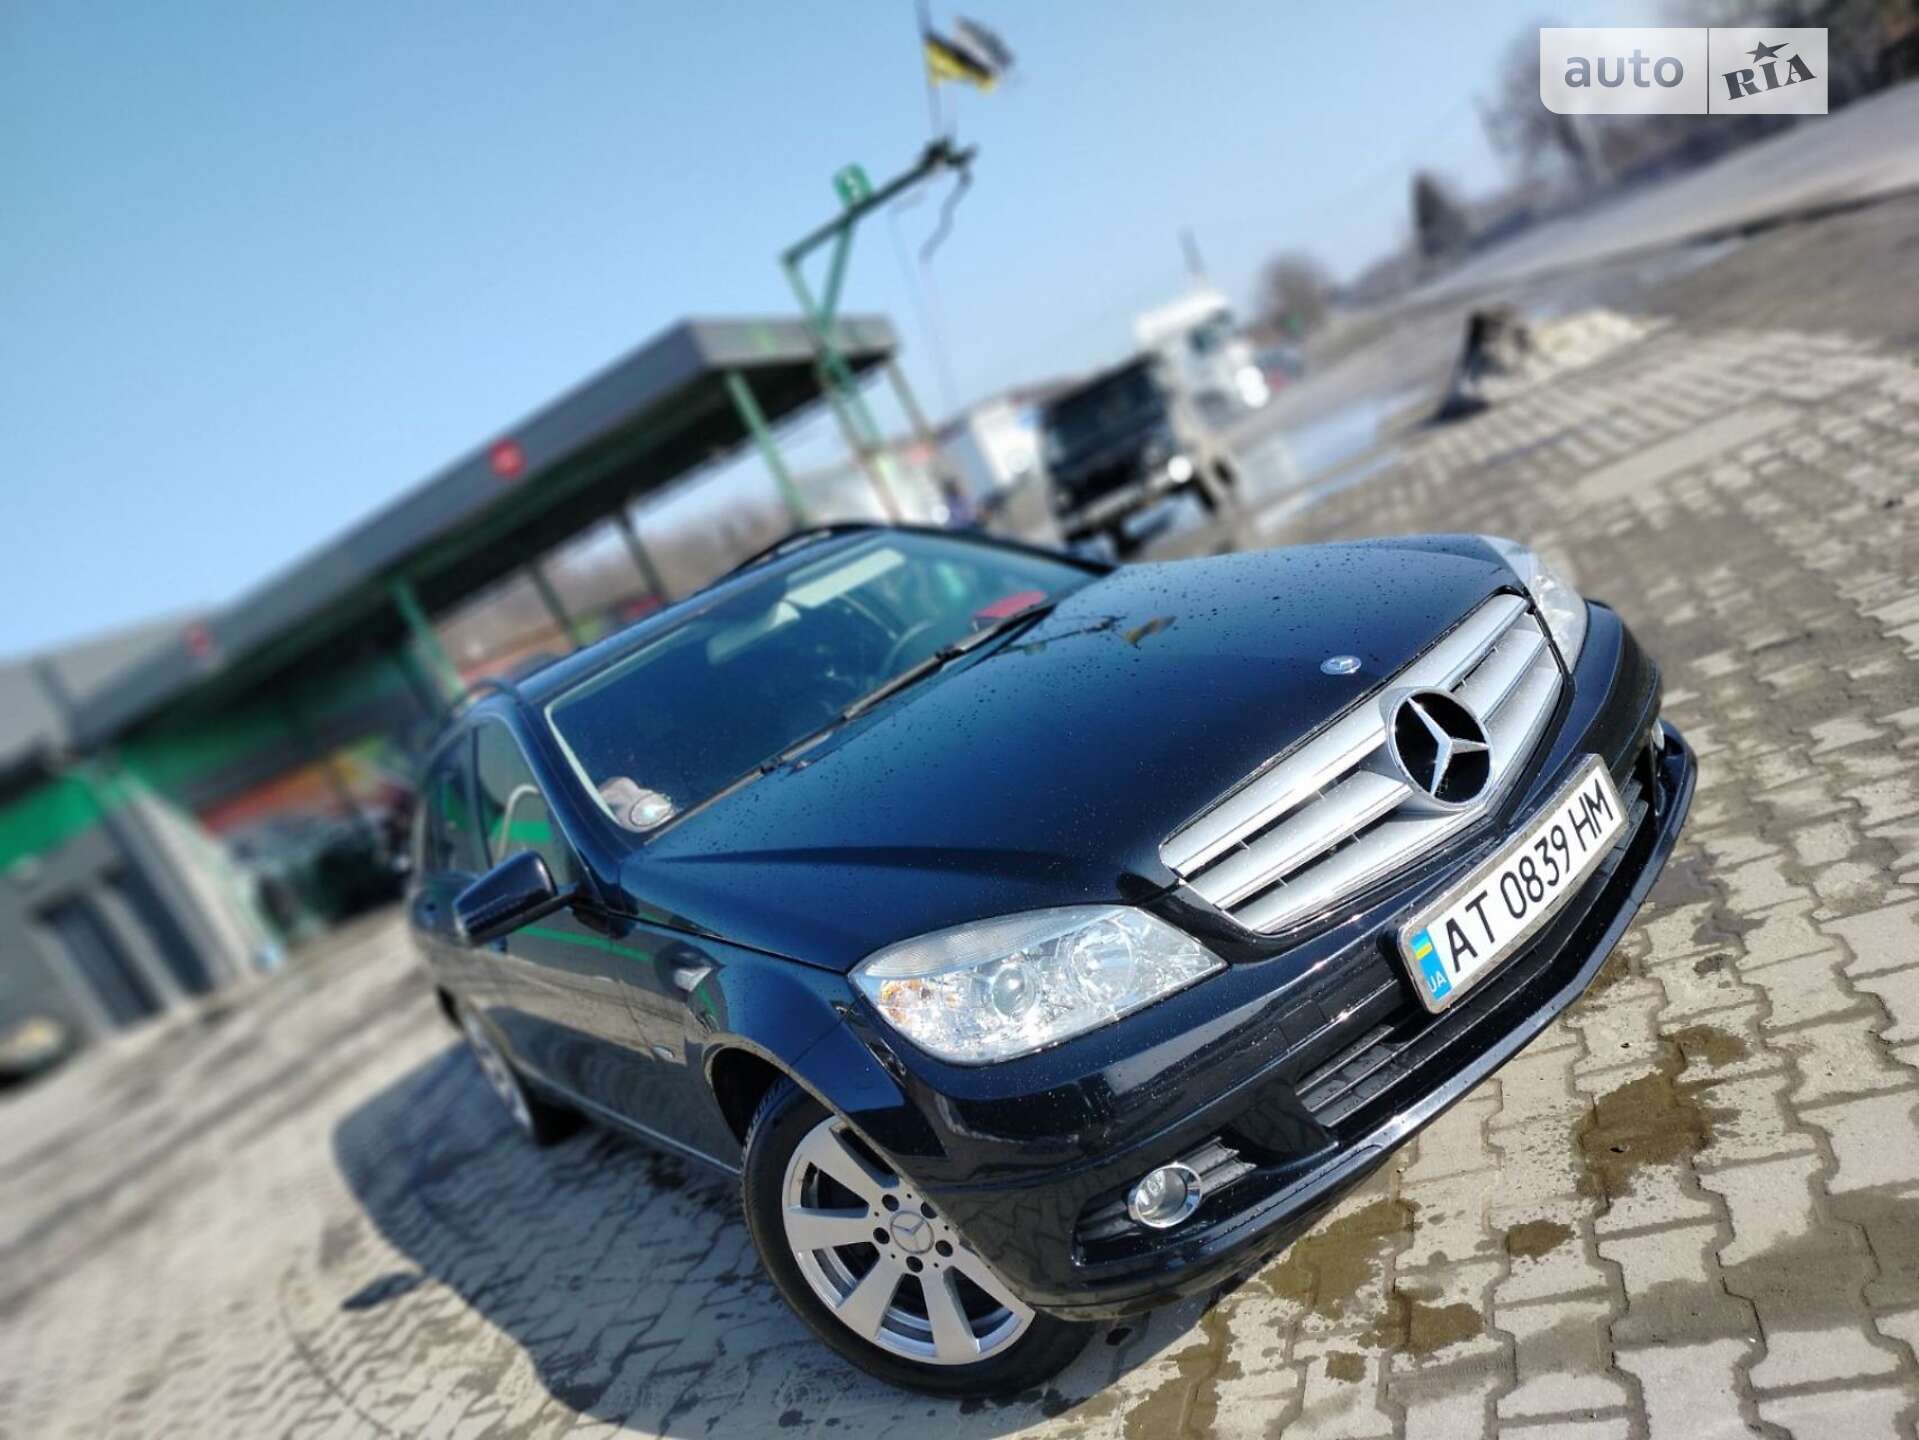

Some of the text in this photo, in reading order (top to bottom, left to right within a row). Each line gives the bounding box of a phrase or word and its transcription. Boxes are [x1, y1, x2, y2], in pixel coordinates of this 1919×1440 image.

[1445, 778, 1614, 973] AT 0839 HM
[1427, 971, 1447, 993] UA
